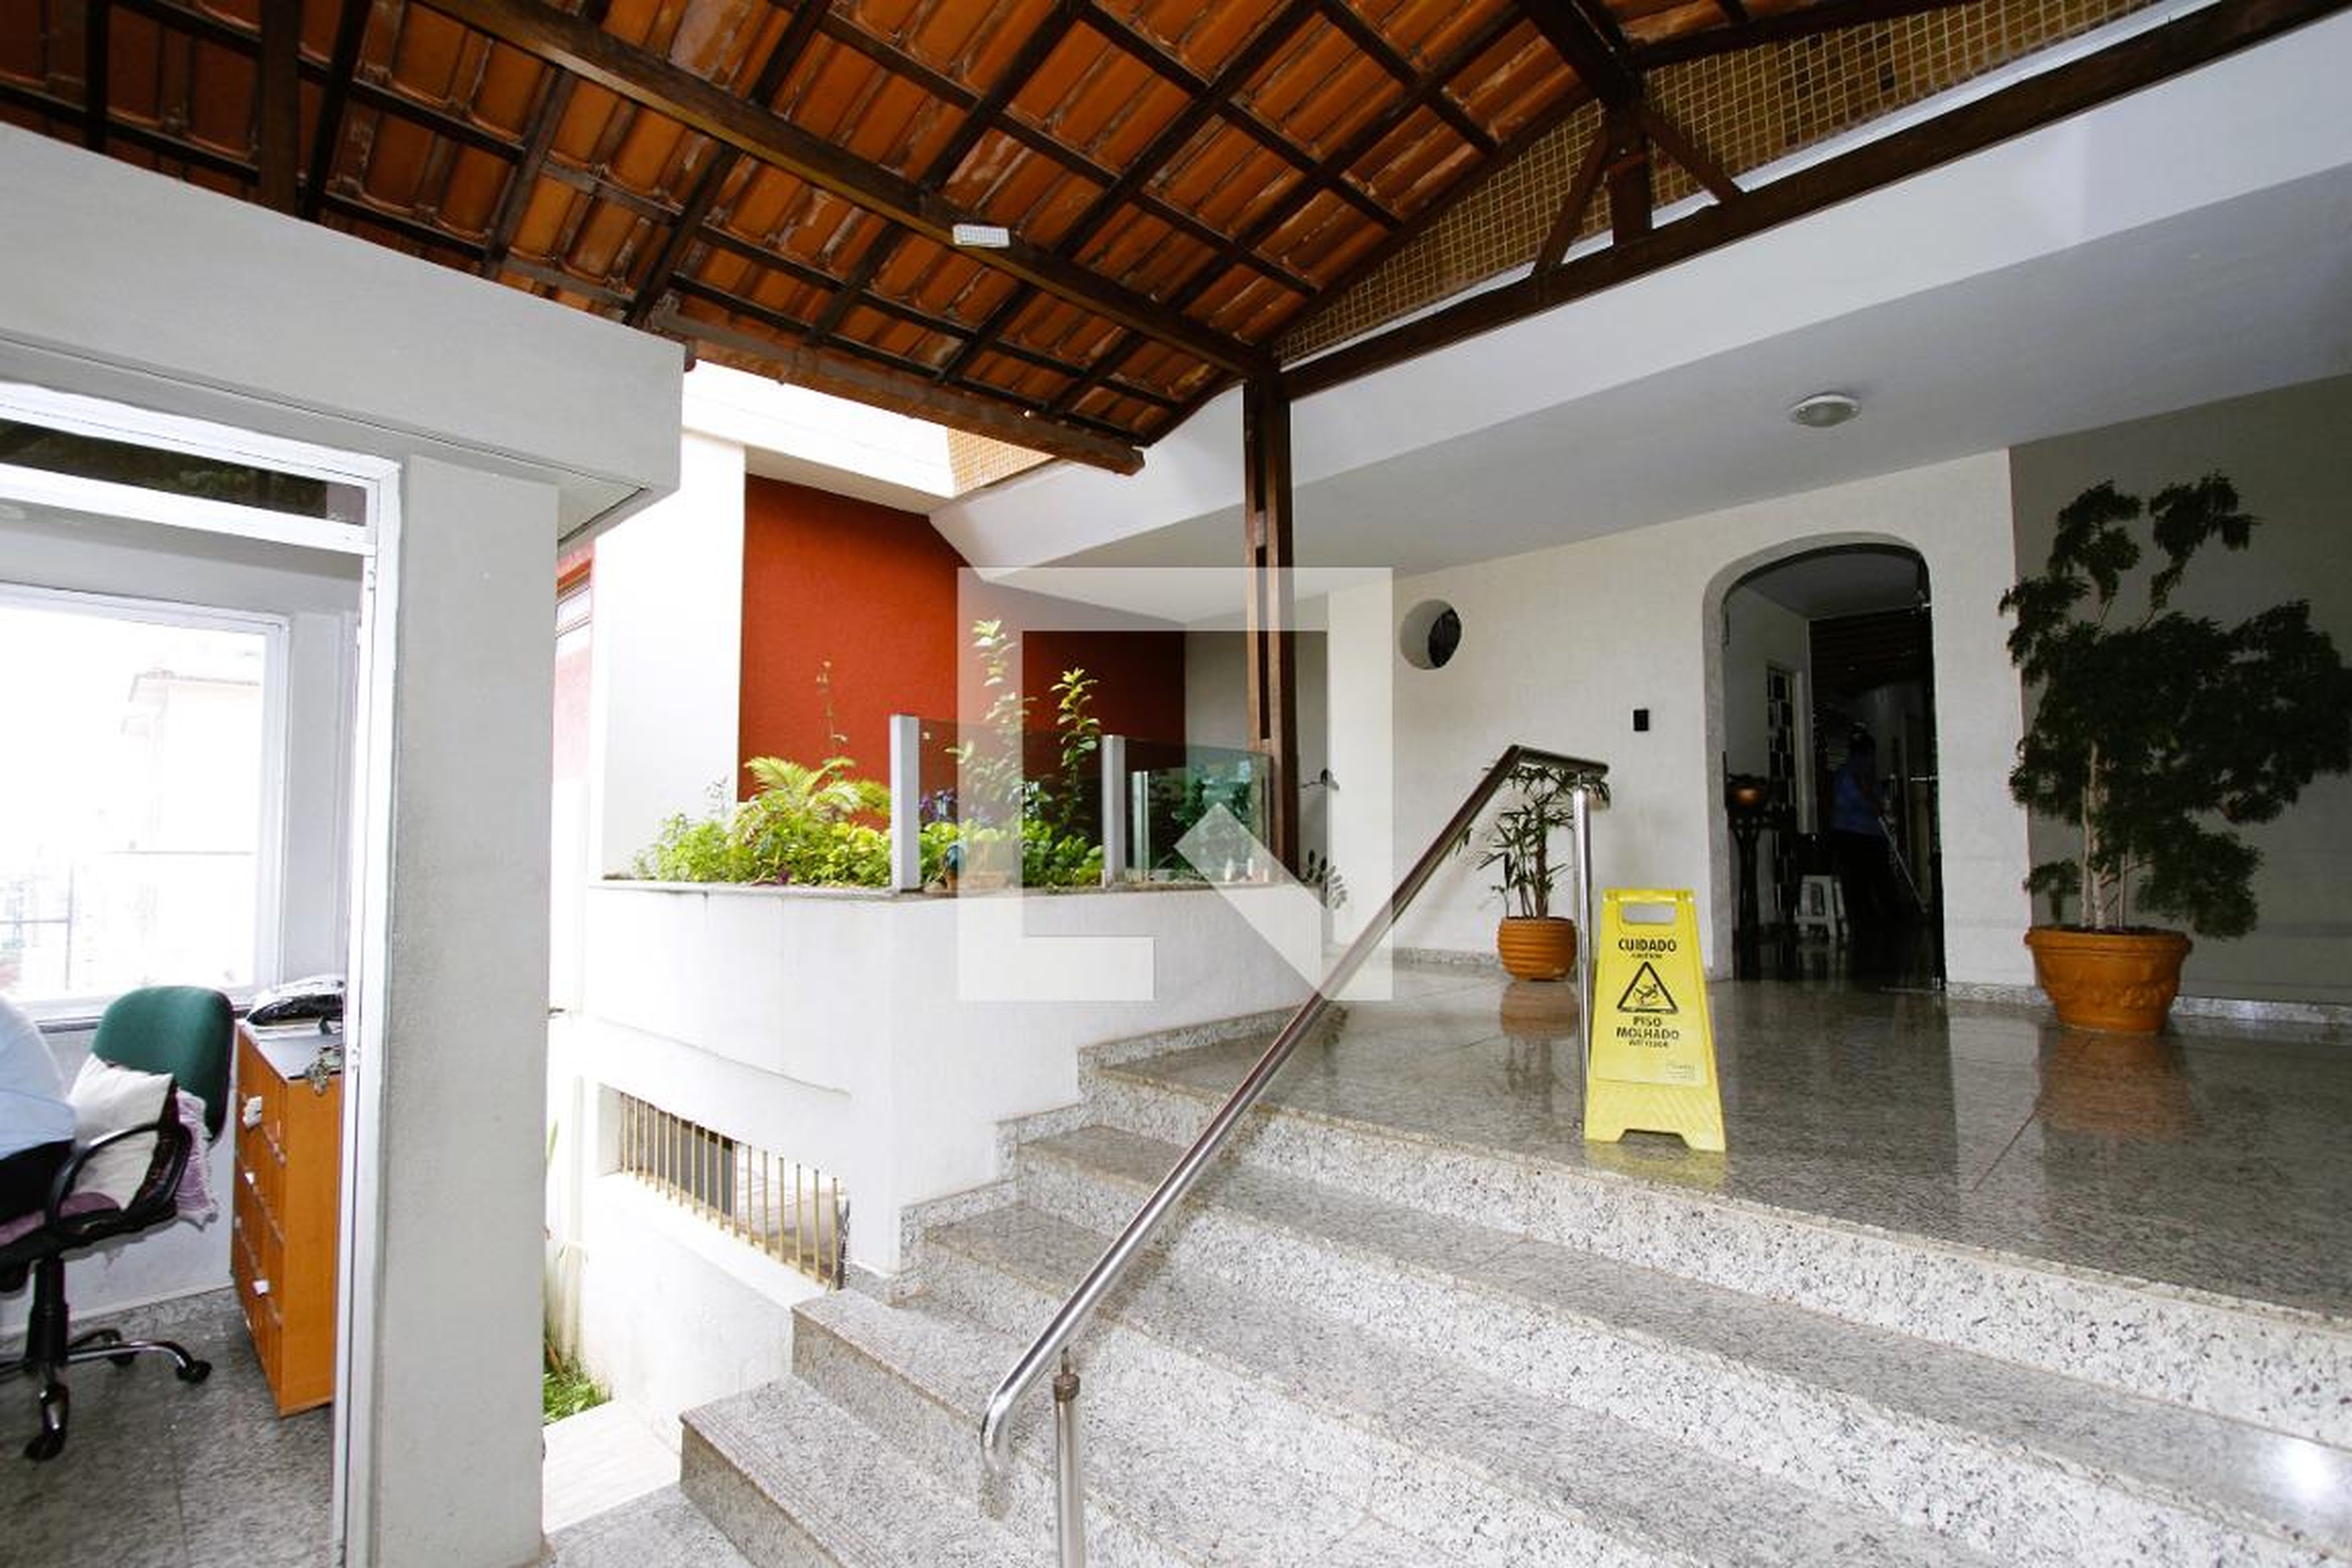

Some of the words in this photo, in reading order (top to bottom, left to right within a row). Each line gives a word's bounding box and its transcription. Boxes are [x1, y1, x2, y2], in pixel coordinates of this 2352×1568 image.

[1618, 938, 1677, 952] CUIDADO
[1633, 1016, 1662, 1027] PISO
[1616, 1027, 1679, 1040] MOLHADO
